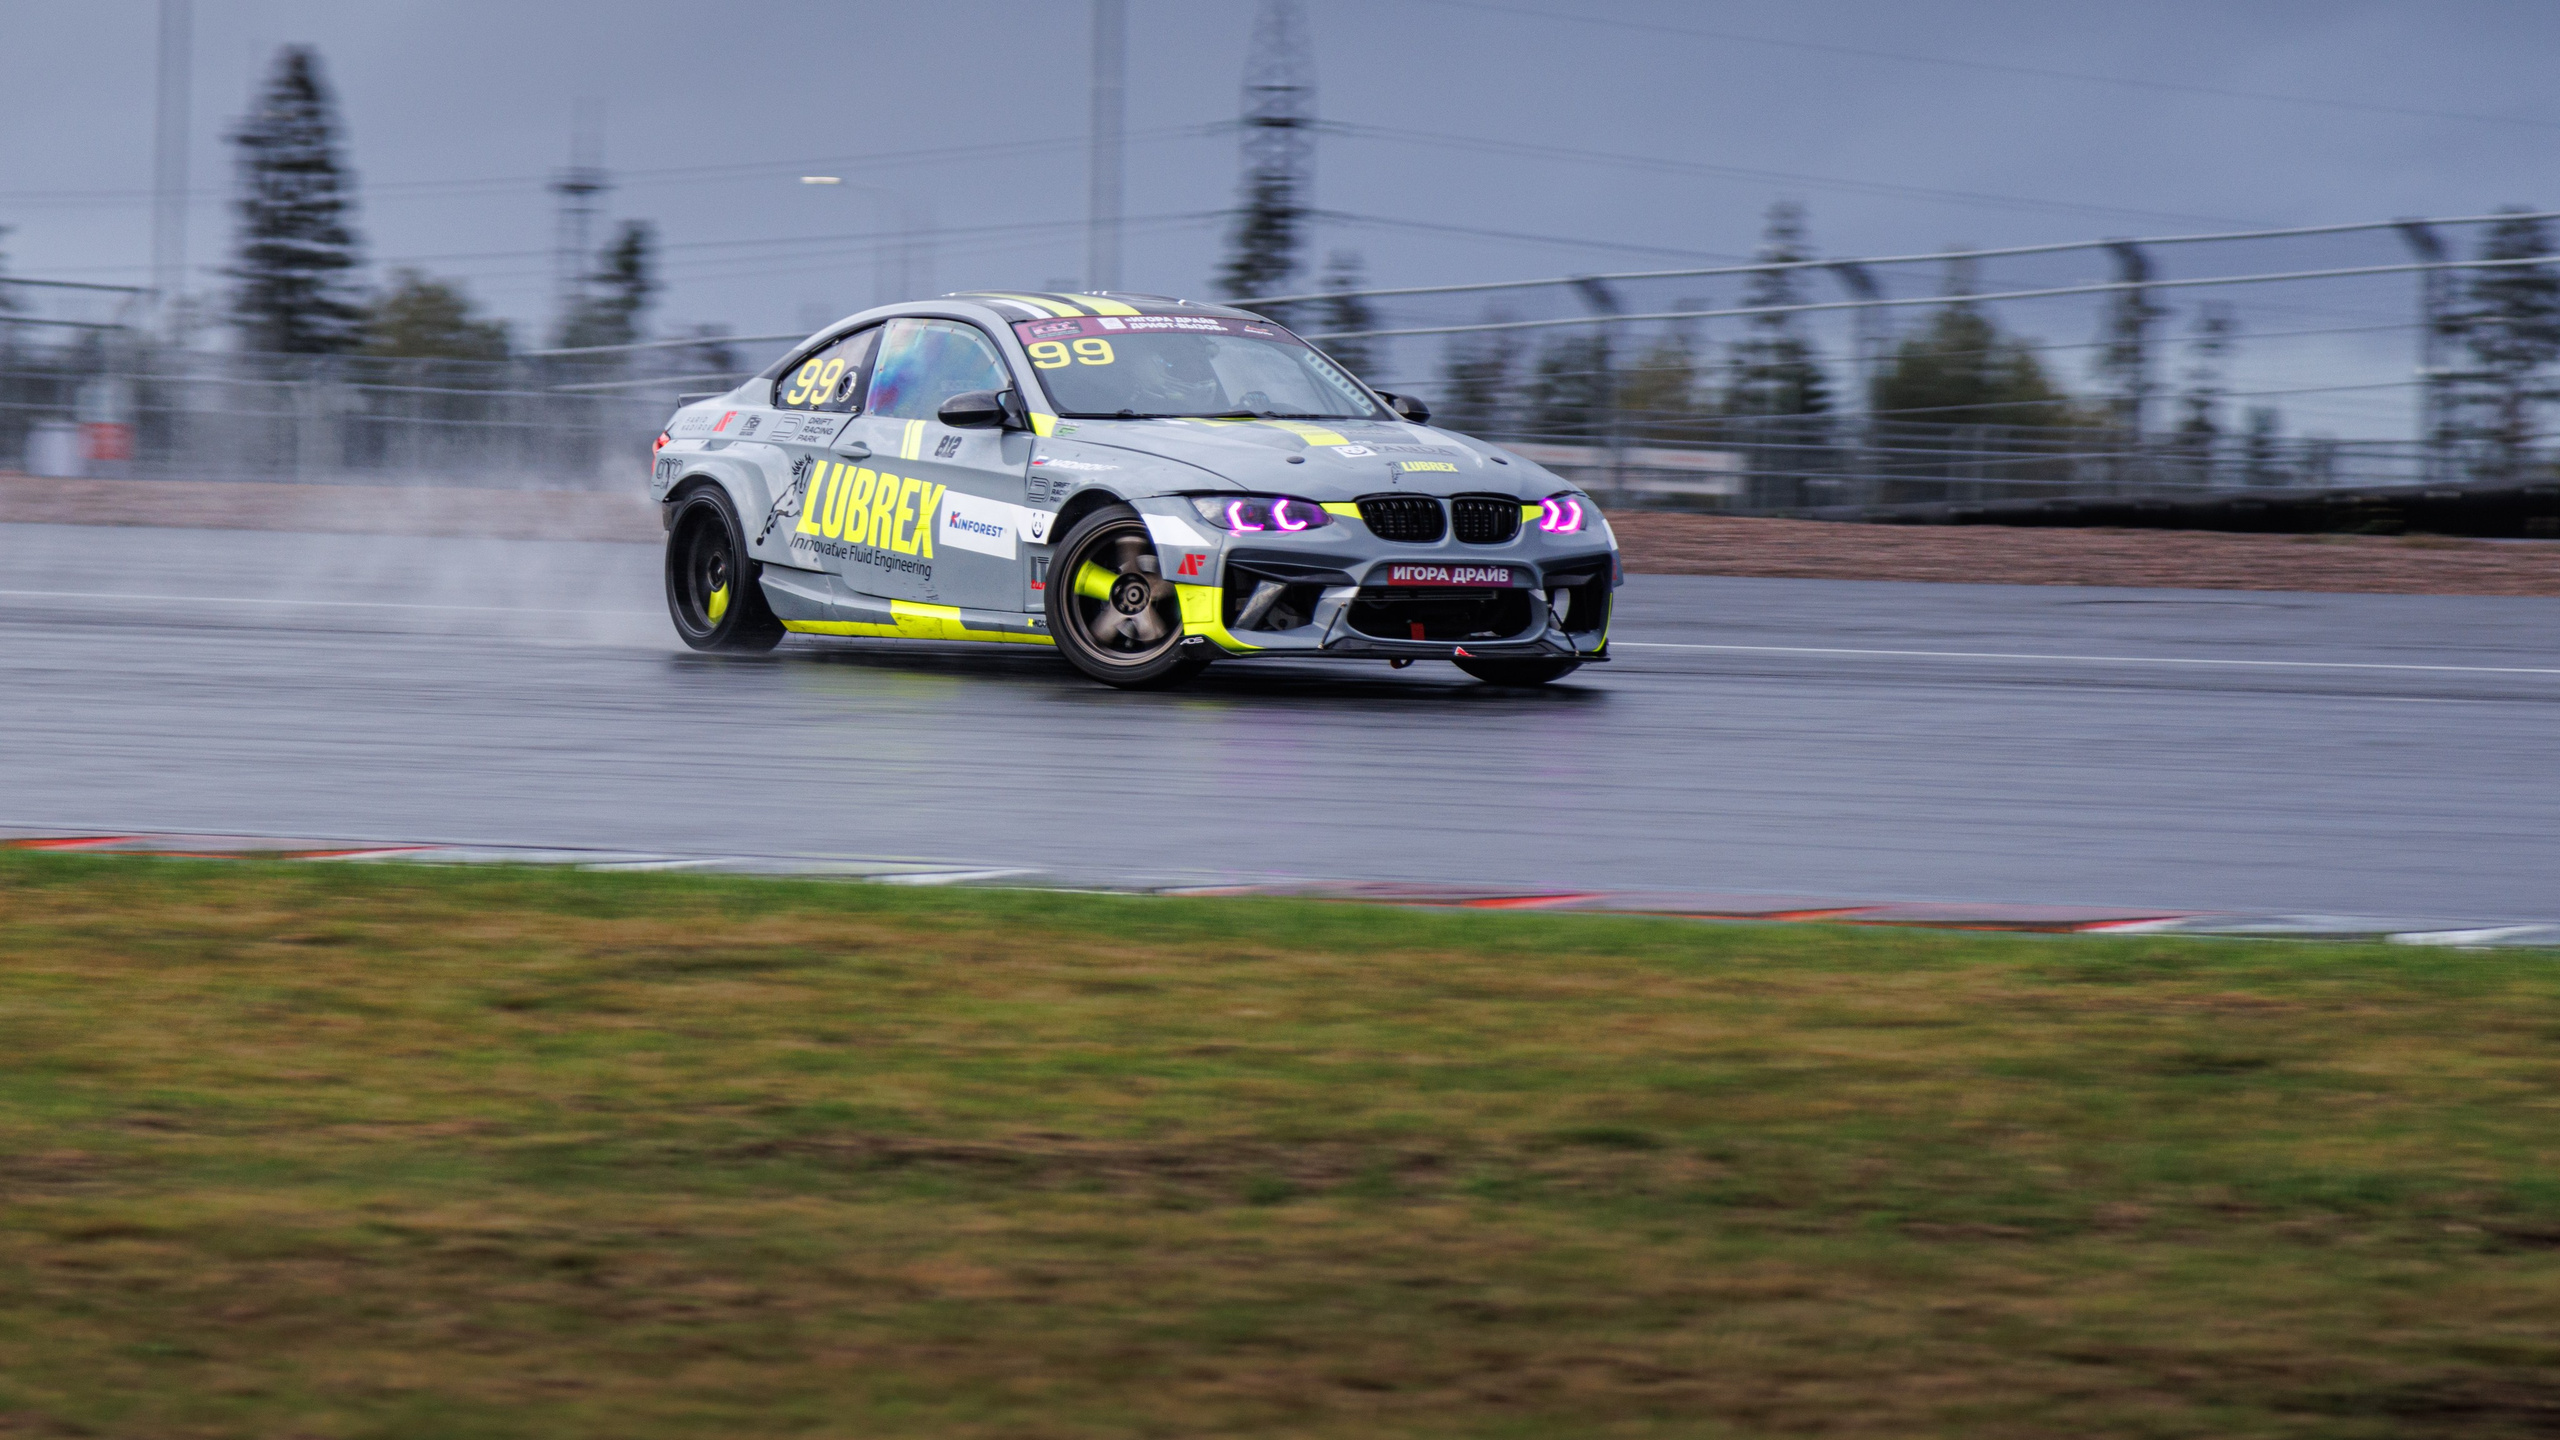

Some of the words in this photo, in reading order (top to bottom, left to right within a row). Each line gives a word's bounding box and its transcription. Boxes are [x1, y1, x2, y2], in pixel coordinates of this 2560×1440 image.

[1028, 338, 1115, 369] 99
[787, 358, 845, 405] 99
[802, 426, 834, 436] RACING
[808, 416, 834, 426] DRIFT
[796, 434, 820, 443] PARK
[1401, 461, 1459, 473] LUBREX
[795, 459, 947, 559] LUBREX
[949, 511, 1003, 538] KINFOREST
[848, 545, 873, 565] Fluid
[873, 550, 932, 581] Engineering
[1393, 566, 1450, 586] ИГОРА
[1453, 565, 1509, 589] ДРАЙВ
